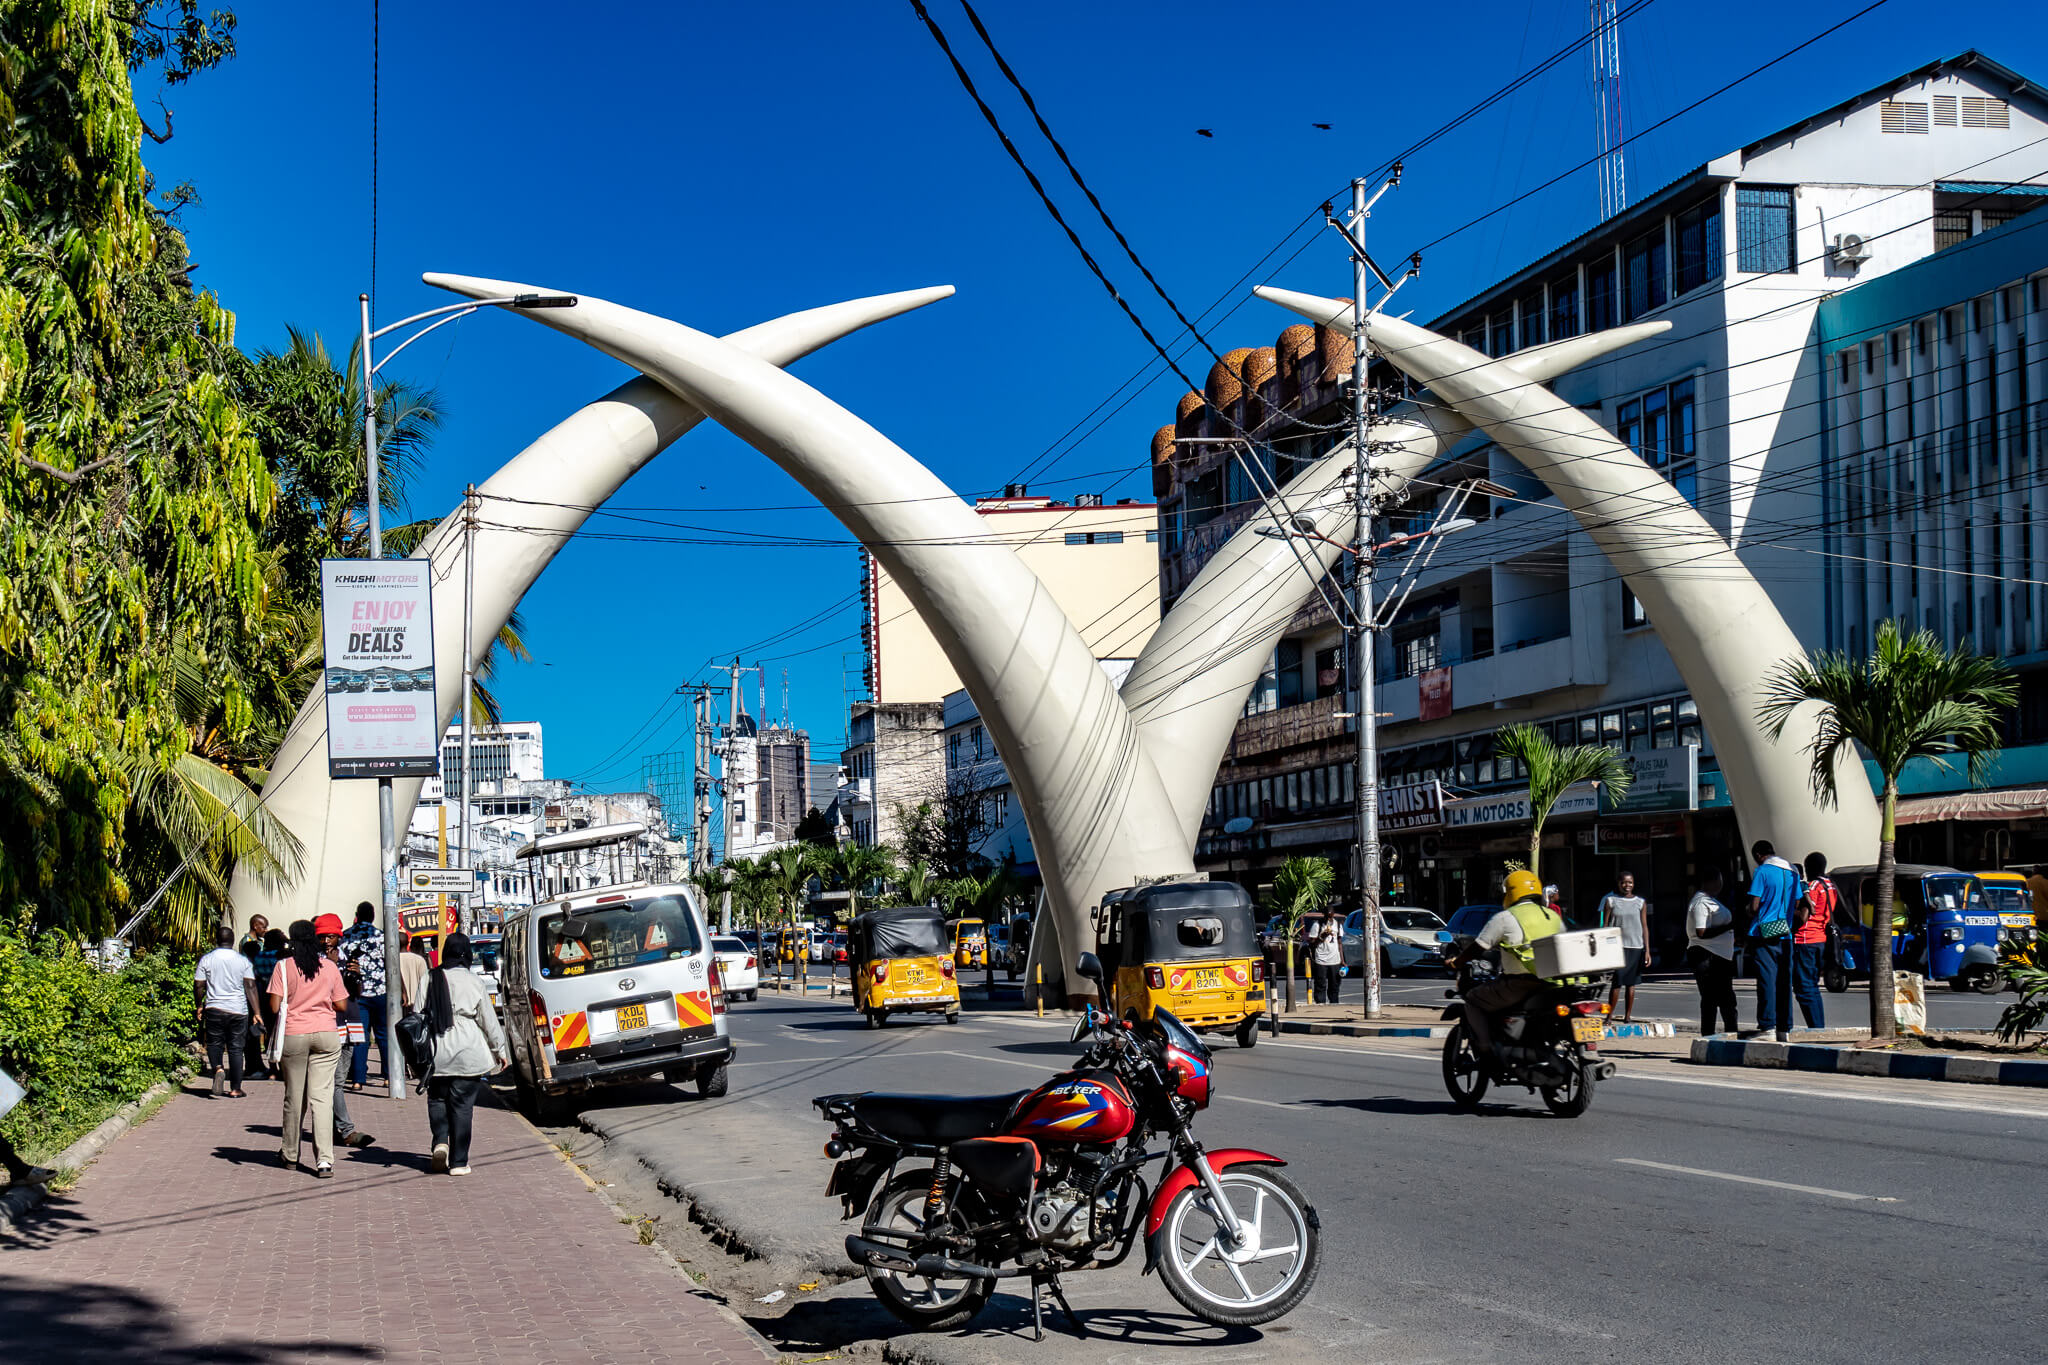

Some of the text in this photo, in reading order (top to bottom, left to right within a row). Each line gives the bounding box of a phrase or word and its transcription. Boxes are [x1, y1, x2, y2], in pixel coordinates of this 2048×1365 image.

[334, 575, 419, 583] KHUSHI MOTORS
[352, 600, 417, 625] ENJOY
[351, 623, 372, 633] OUR
[348, 632, 405, 653] DEALS
[1472, 801, 1524, 823] MOTORS
[1408, 813, 1437, 826] DAWA
[1606, 831, 1625, 840] CAR
[1627, 831, 1649, 840] HIRE
[689, 960, 701, 970] 80
[1195, 969, 1220, 979] KTWC
[1196, 978, 1221, 988] 820L
[623, 1006, 643, 1018] KDL
[1054, 1085, 1103, 1096] BOXER
